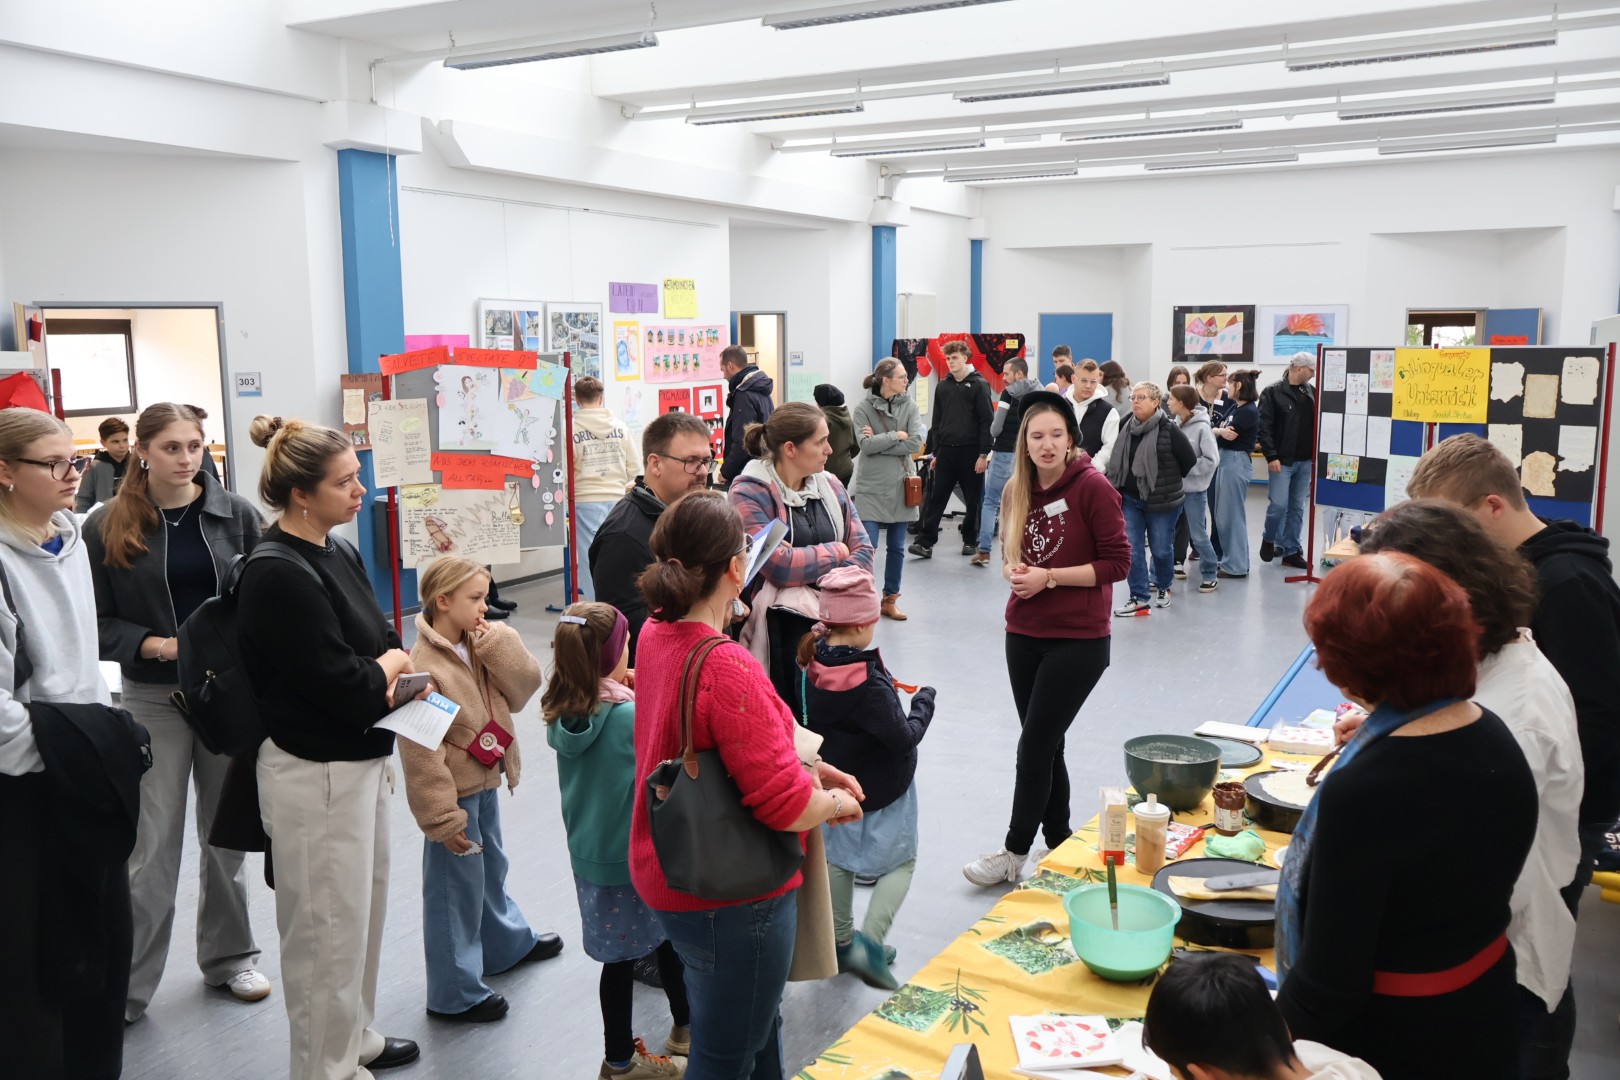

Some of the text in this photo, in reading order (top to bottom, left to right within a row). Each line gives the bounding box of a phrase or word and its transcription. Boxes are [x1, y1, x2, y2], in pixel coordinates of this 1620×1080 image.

[383, 351, 436, 370] SALVETE
[458, 351, 510, 364] SPECTATE
[1398, 357, 1484, 384] Bilingualer
[239, 378, 255, 386] 303
[1408, 382, 1478, 408] Unterricht
[433, 456, 451, 466] AUS
[458, 459, 476, 467] DEM
